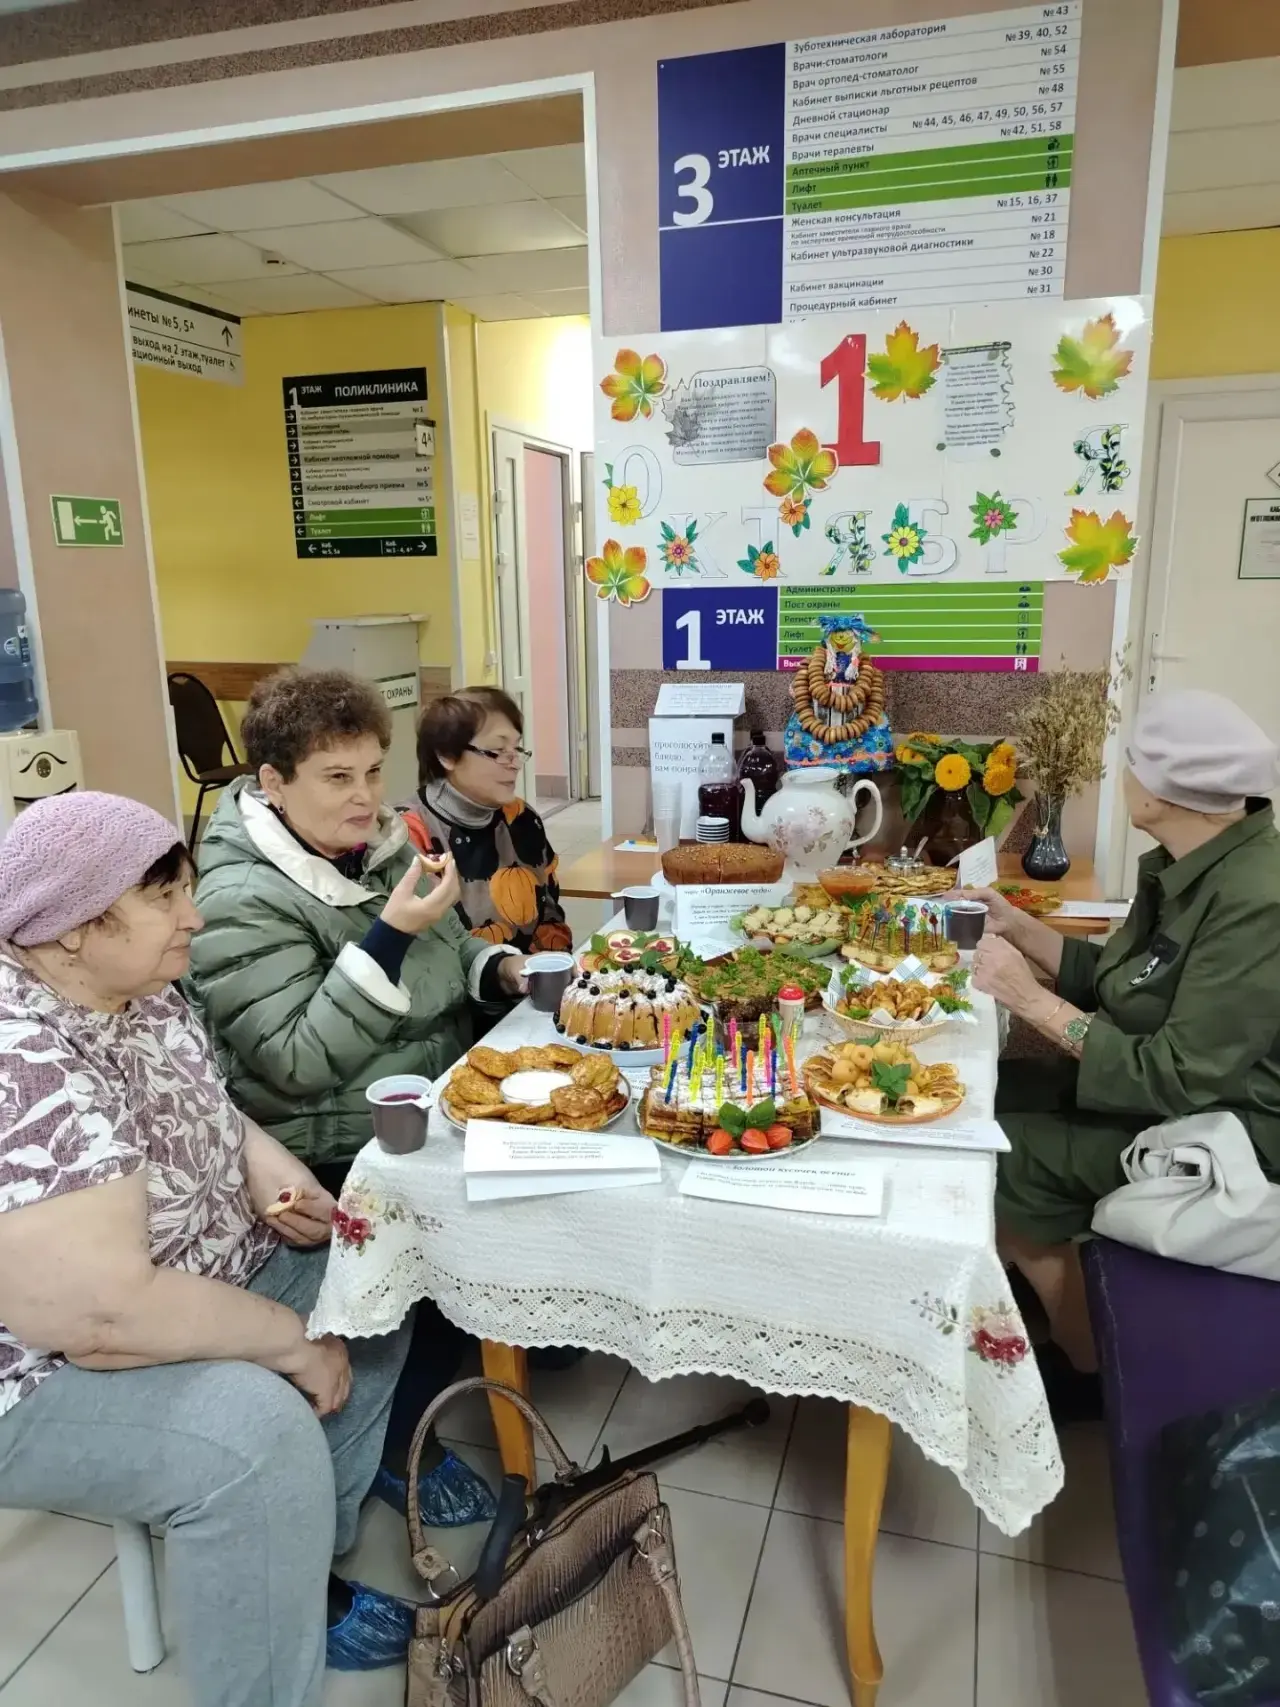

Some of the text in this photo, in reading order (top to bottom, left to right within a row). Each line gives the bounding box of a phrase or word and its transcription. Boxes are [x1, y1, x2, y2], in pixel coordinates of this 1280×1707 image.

[793, 24, 946, 54] Зуботехническая лаборатория
[1055, 25, 1068, 36] 52
[793, 51, 888, 72] Врачи-стоматологи
[793, 65, 919, 92] Врач ортопед-стоматолог
[792, 76, 978, 108] Кабинет выписки льготных рецептов
[1050, 102, 1063, 113] 57
[792, 106, 890, 127] Дневной стационар
[792, 123, 887, 145] Врачи специалисты
[1050, 120, 1062, 131] 58
[718, 145, 770, 168] ЭТАЖ
[792, 143, 874, 163] Врачи терапевты
[792, 159, 870, 176] Аптечный пункт
[673, 154, 714, 227] 3
[792, 182, 817, 195] Лифт
[792, 200, 822, 213] Туалет
[1045, 193, 1057, 204] 37
[791, 207, 901, 227] Женская консультация
[790, 237, 974, 261] Кабинет ультразвуковой диагностики
[790, 278, 884, 293] Кабинет вакцинации
[790, 295, 897, 313] Процедурный кабинет
[133, 336, 161, 351] выход
[162, 343, 172, 353] на
[177, 360, 203, 374] выход
[694, 372, 770, 389] Поздравляем!
[289, 381, 419, 409] 1 ЭТАЖ ПОЛИКЛИНИКА
[820, 334, 881, 466] 1
[786, 584, 856, 594] Администратор
[784, 600, 840, 610] Пост охраны
[676, 609, 764, 670] 1 ЭТАЖ
[783, 630, 804, 641] Лифт
[784, 645, 812, 655] Туалет
[783, 659, 800, 668] Вых
[387, 685, 413, 699] ОХРАНЫ
